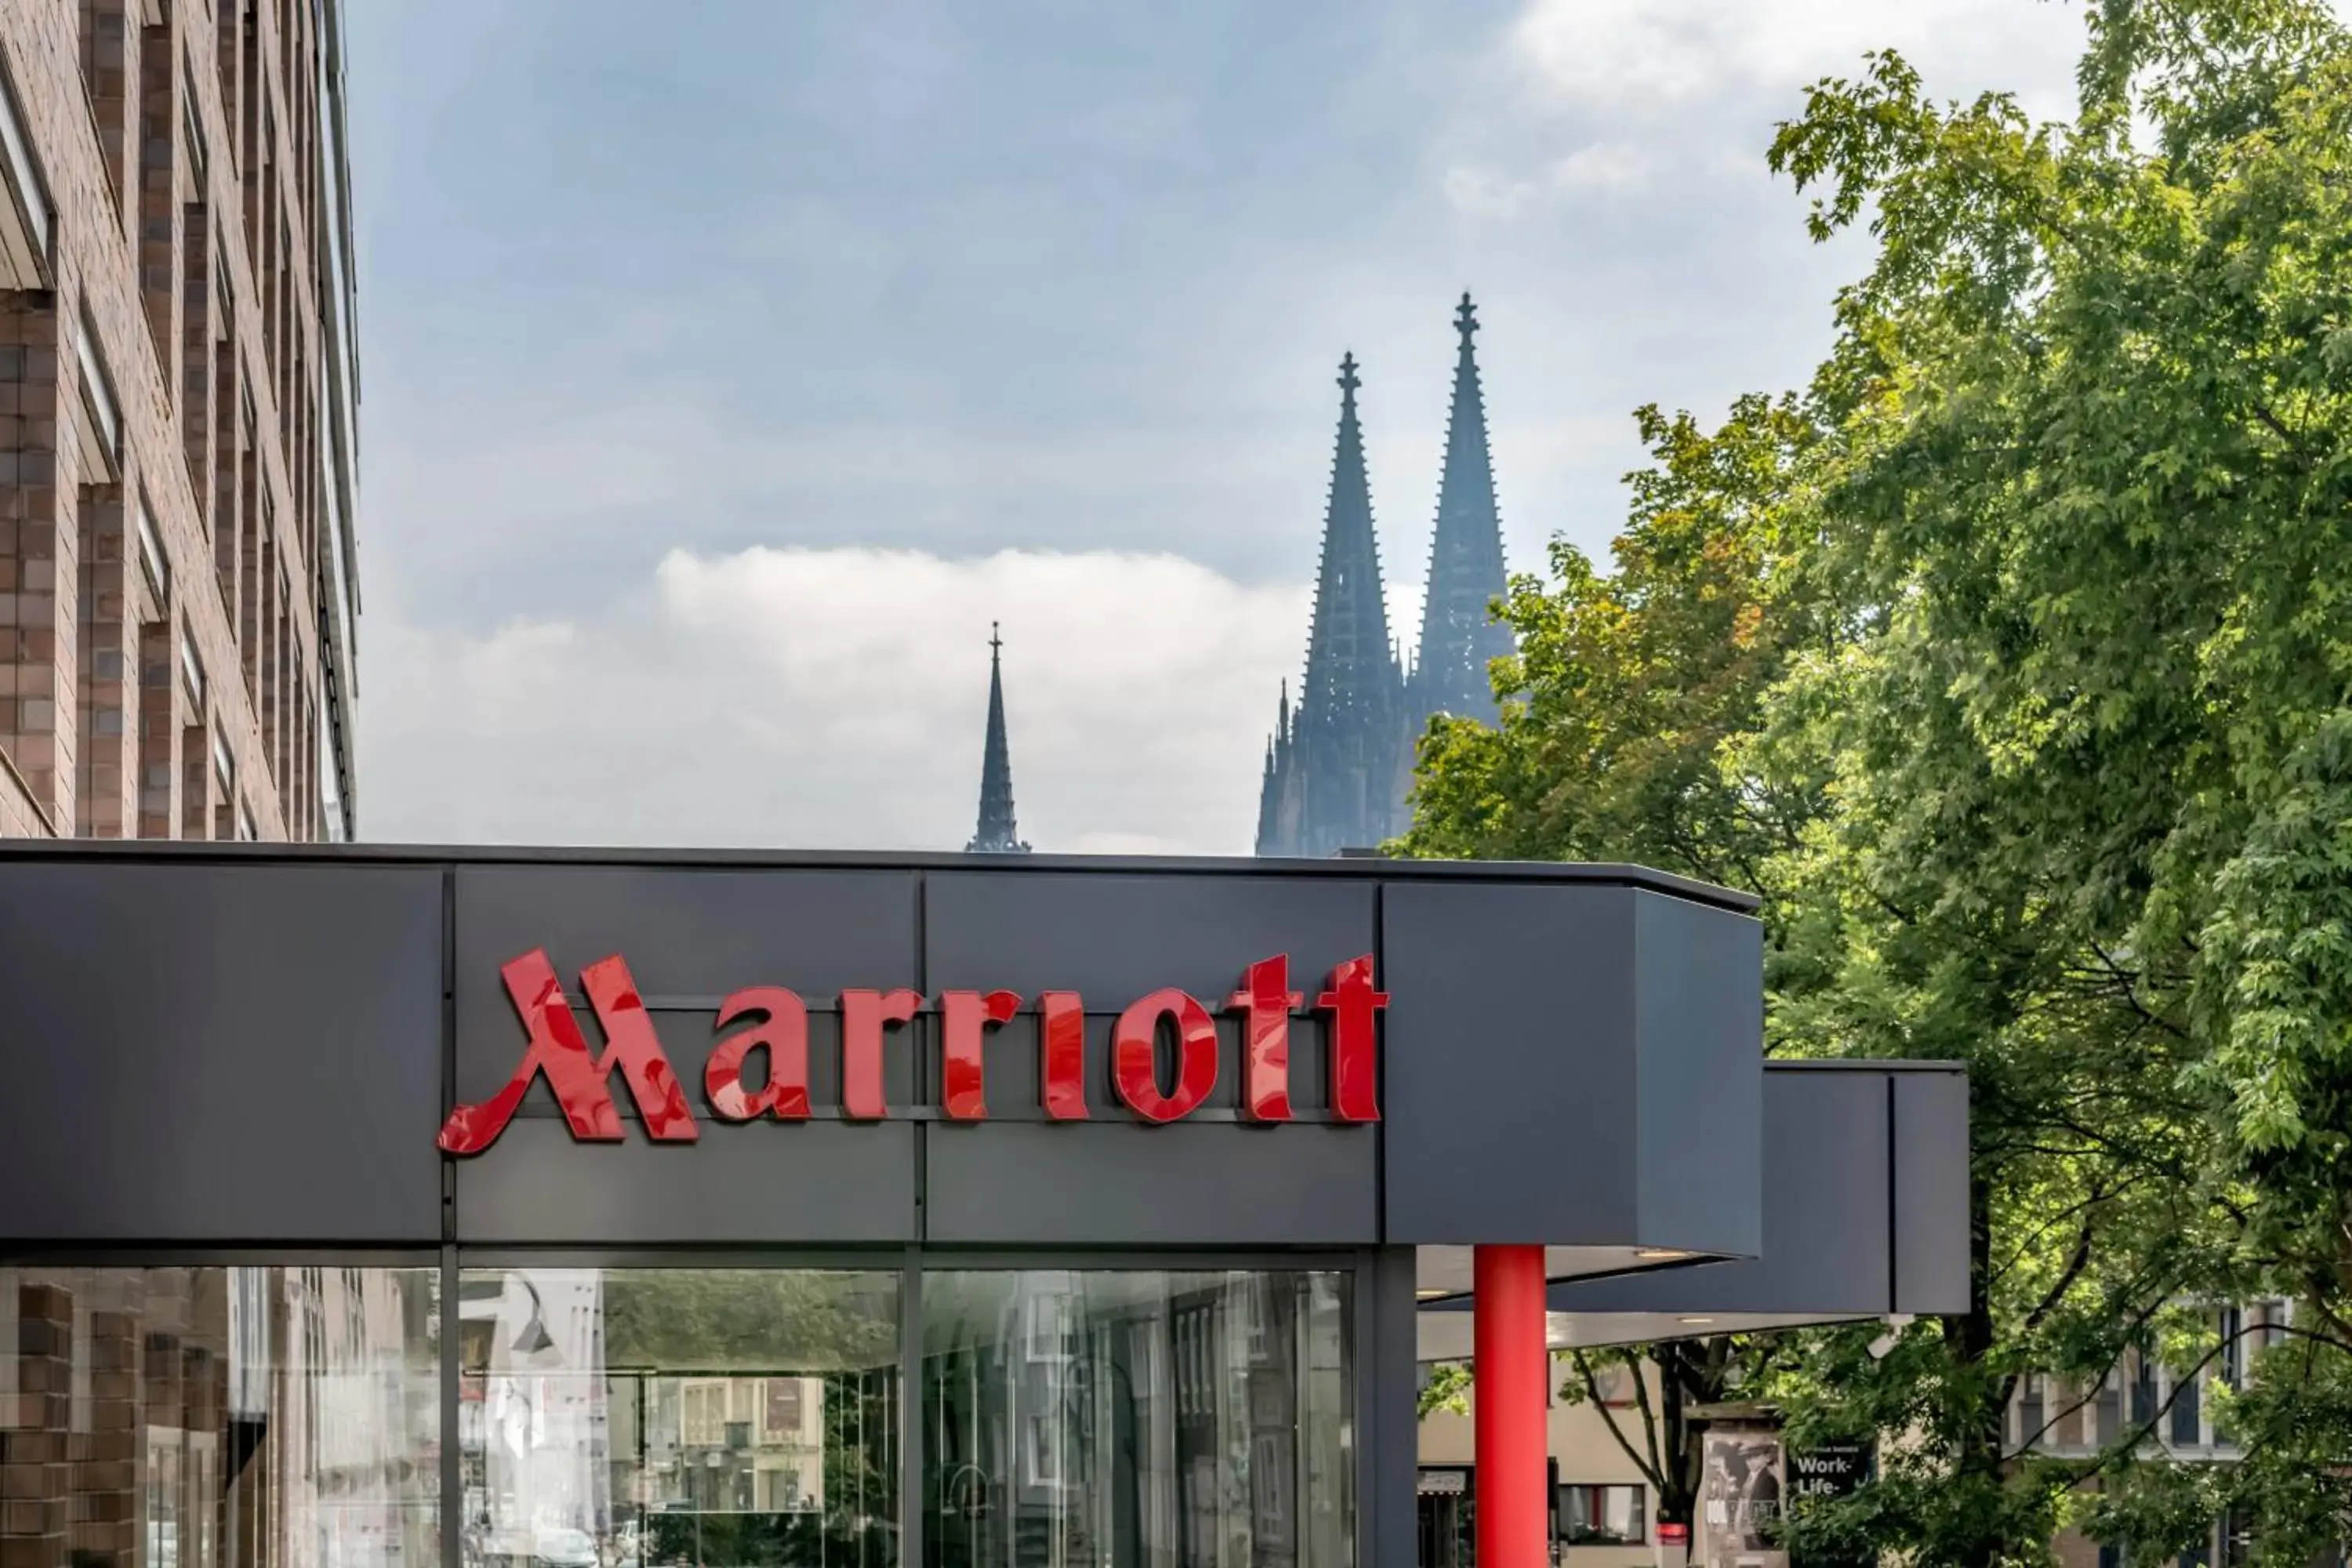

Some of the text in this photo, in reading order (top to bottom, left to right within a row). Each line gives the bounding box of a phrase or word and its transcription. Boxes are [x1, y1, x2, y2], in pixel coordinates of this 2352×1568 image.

[437, 946, 1390, 1156] Marriott
[1798, 1456, 1852, 1473] Work-
[1798, 1478, 1840, 1494] Life-
